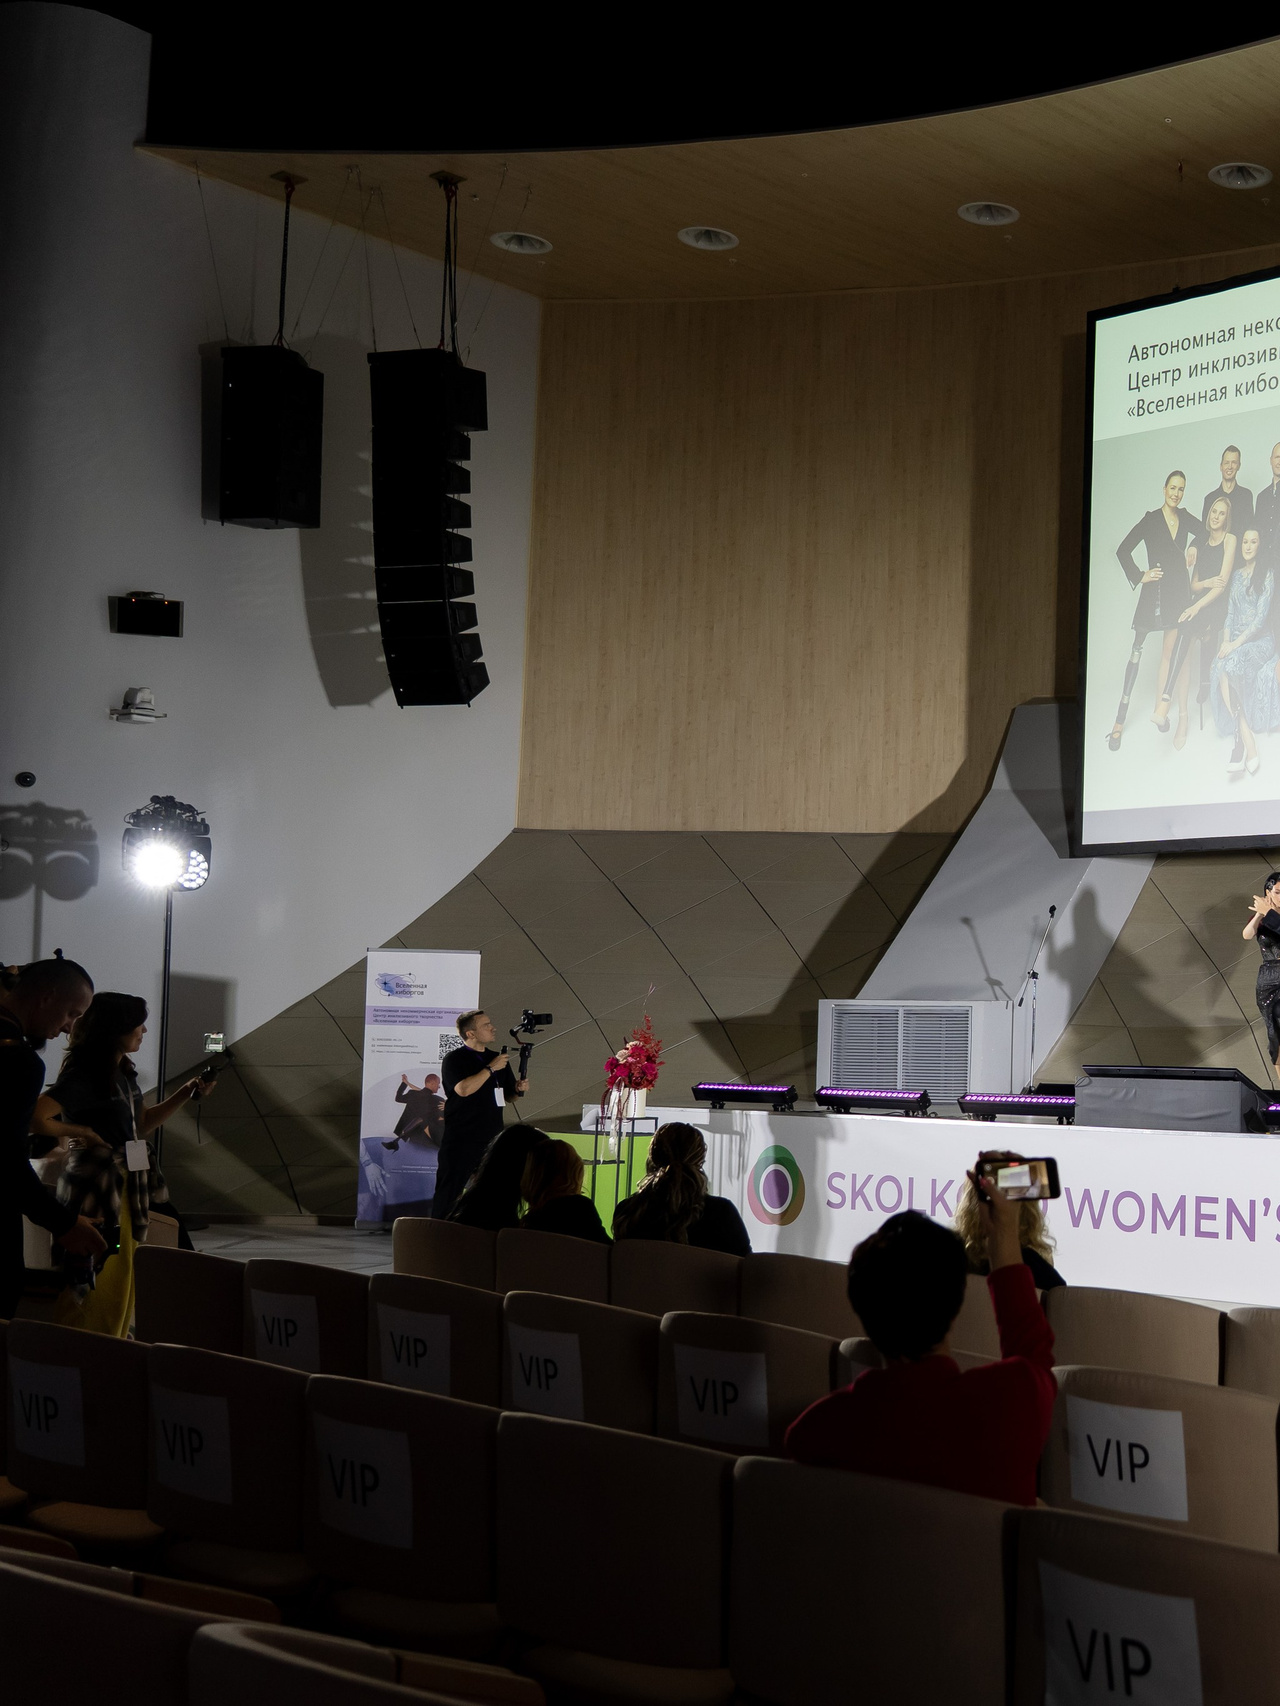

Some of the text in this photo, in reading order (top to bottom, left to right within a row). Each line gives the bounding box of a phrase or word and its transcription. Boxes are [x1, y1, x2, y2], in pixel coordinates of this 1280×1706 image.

[1127, 325, 1236, 364] Автономная
[1127, 365, 1182, 393] Центр
[1126, 382, 1229, 420] «Вселенная
[825, 1169, 1049, 1217] SKOLK
[261, 1314, 298, 1348] VIP
[389, 1331, 428, 1369] VIP
[518, 1352, 559, 1391] VIP
[19, 1389, 59, 1433] VIP
[689, 1375, 739, 1417] VIP
[161, 1418, 205, 1468] VIP
[1086, 1433, 1150, 1483] VIP
[327, 1453, 380, 1507] VIP
[1066, 1617, 1153, 1697] VIP
